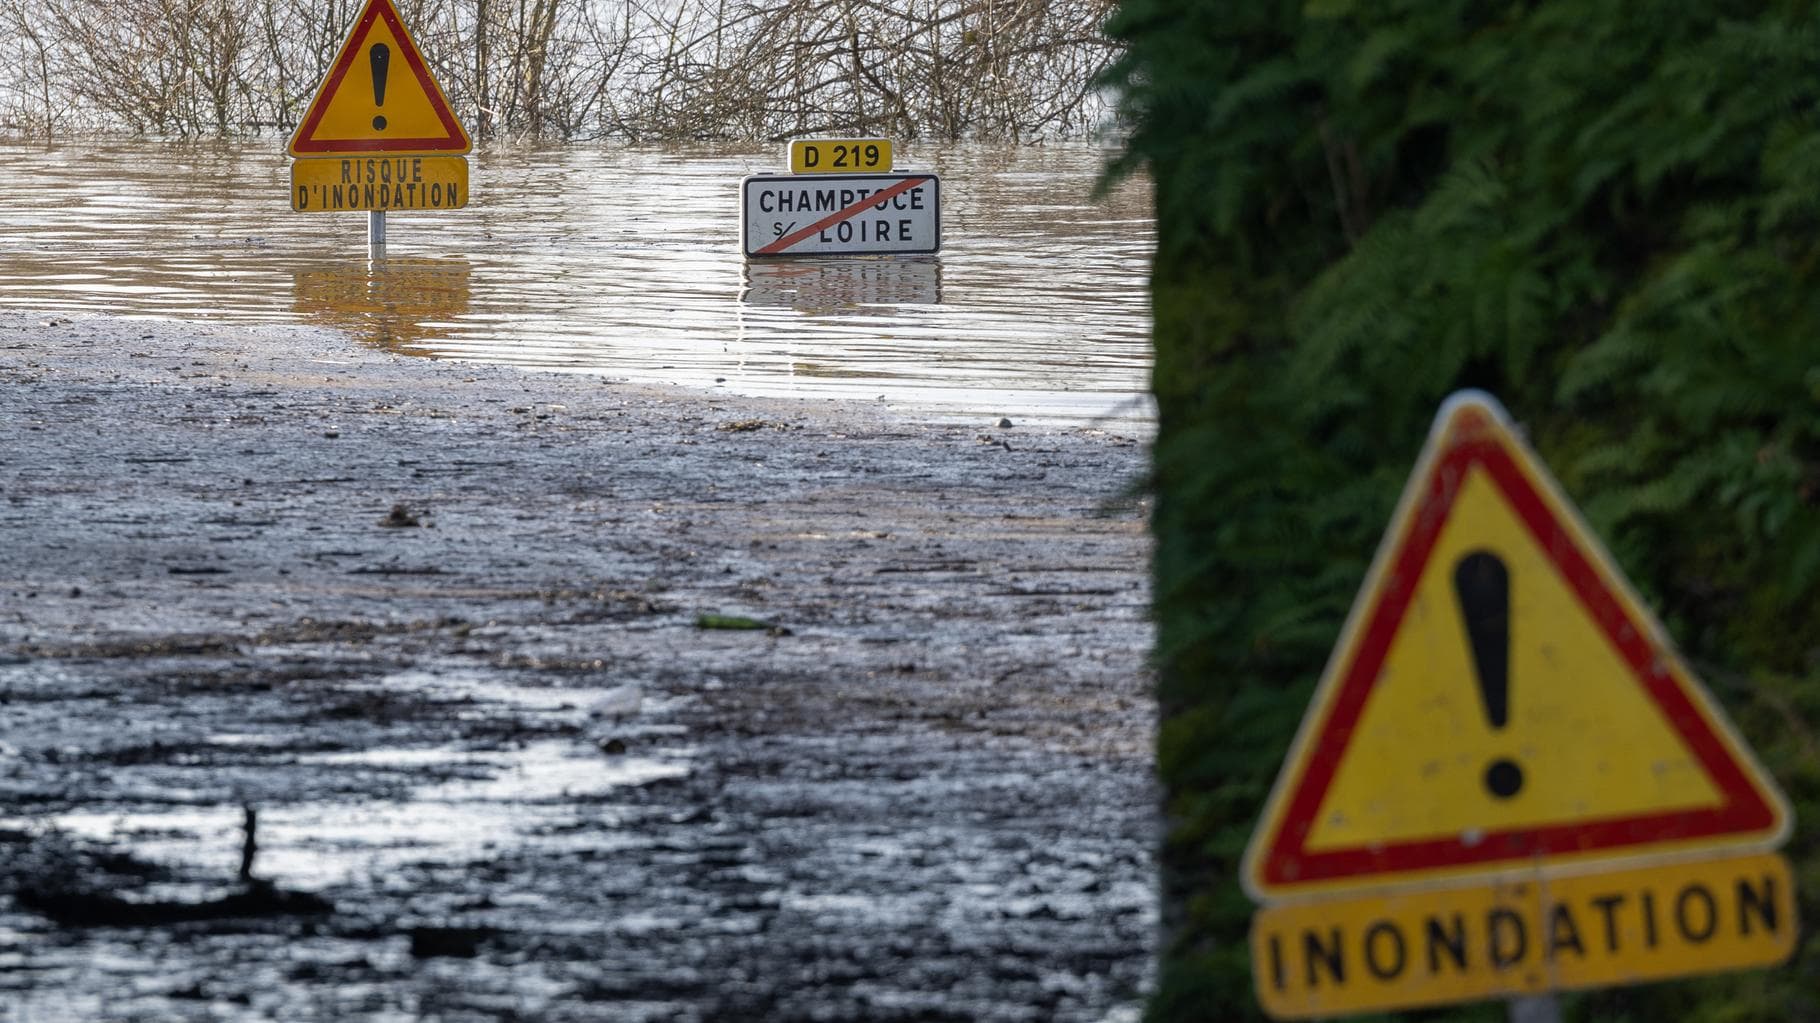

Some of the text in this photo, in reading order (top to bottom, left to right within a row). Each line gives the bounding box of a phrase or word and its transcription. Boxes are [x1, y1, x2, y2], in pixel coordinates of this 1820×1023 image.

[804, 144, 880, 168] D 219
[341, 159, 422, 184] RISQUE
[298, 182, 458, 209] D'INONDATION
[820, 219, 912, 243] LOIRE
[1269, 874, 1780, 993] INONDATION
